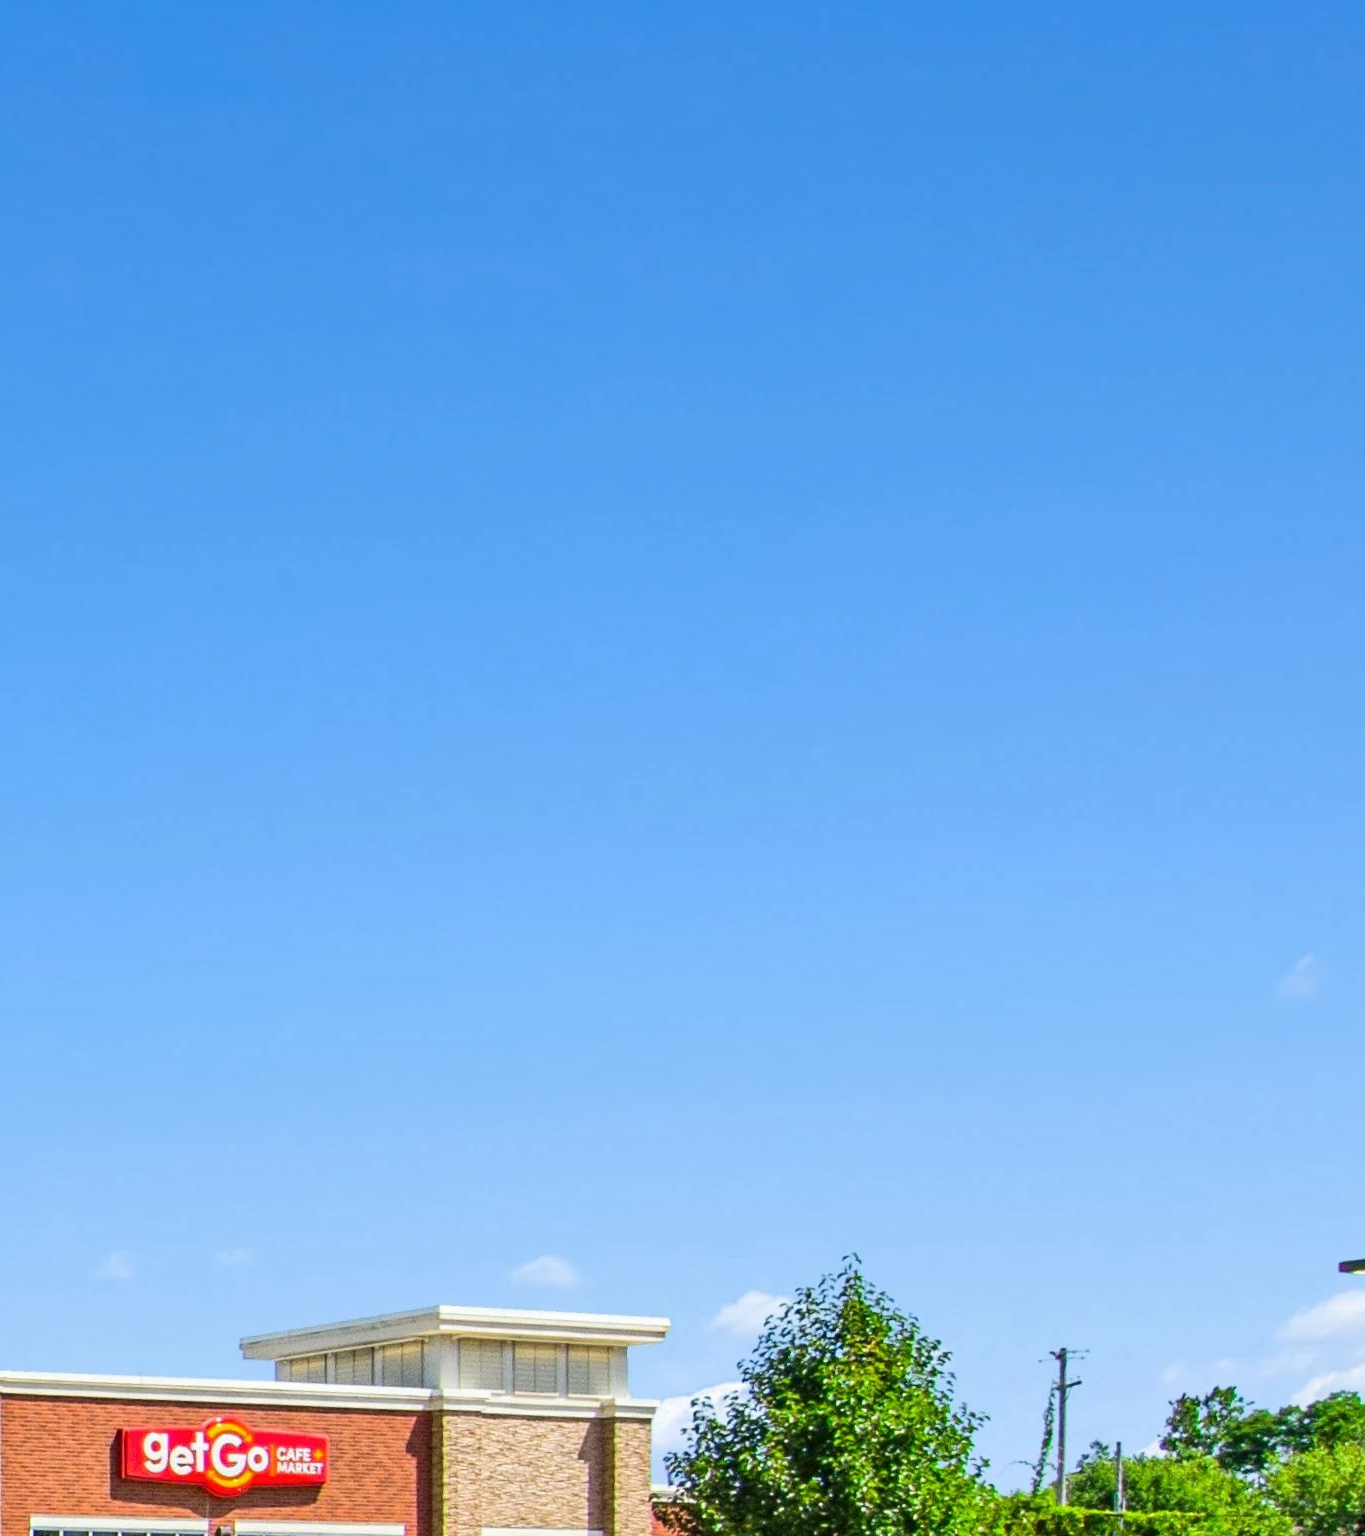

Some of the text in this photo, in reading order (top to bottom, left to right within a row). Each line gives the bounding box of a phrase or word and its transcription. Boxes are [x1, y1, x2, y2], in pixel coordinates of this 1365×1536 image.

[143, 1431, 269, 1478] getGo
[276, 1447, 312, 1462] CAFE
[276, 1462, 324, 1475] MARKET
